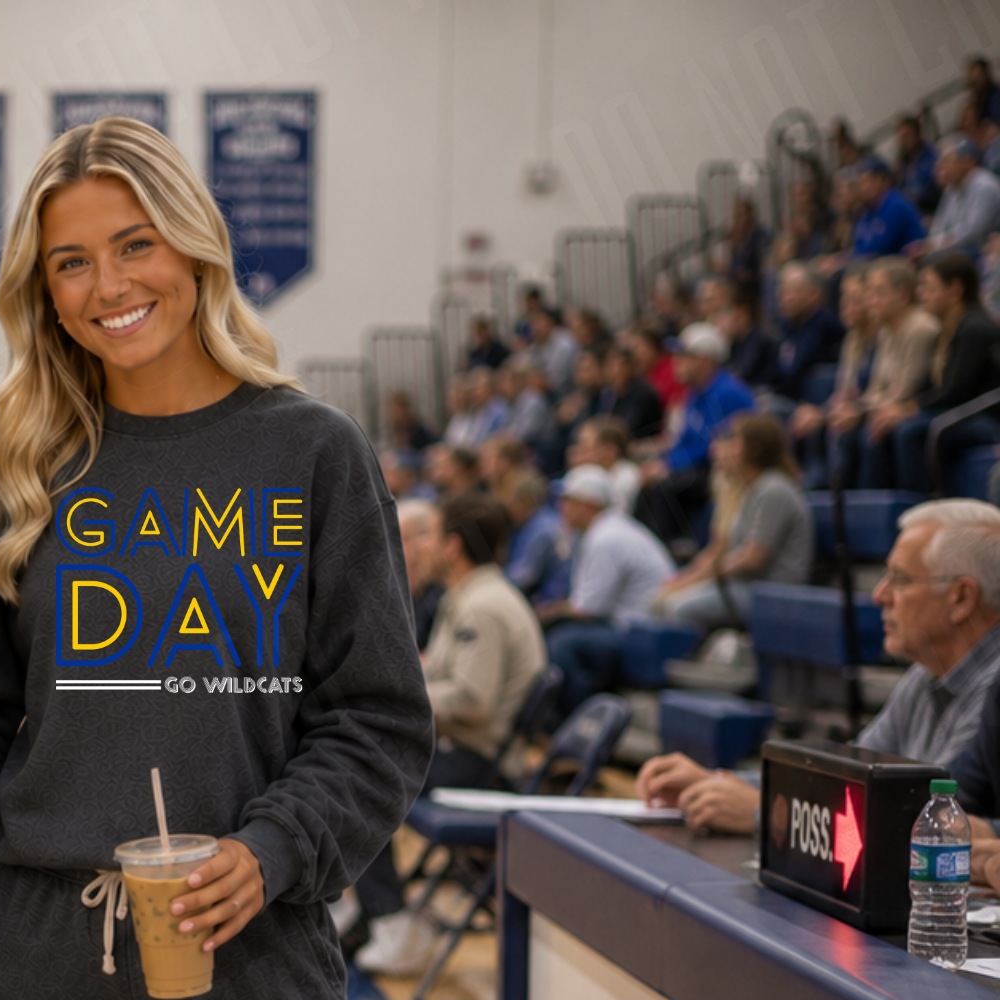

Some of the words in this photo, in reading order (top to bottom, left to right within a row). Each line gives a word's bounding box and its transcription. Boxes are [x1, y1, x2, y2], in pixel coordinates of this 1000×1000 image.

[56, 487, 303, 557] GAME
[56, 564, 303, 667] DAY
[164, 676, 196, 693] GO
[203, 676, 303, 694] WILDCATS
[790, 797, 834, 862] POSS.
